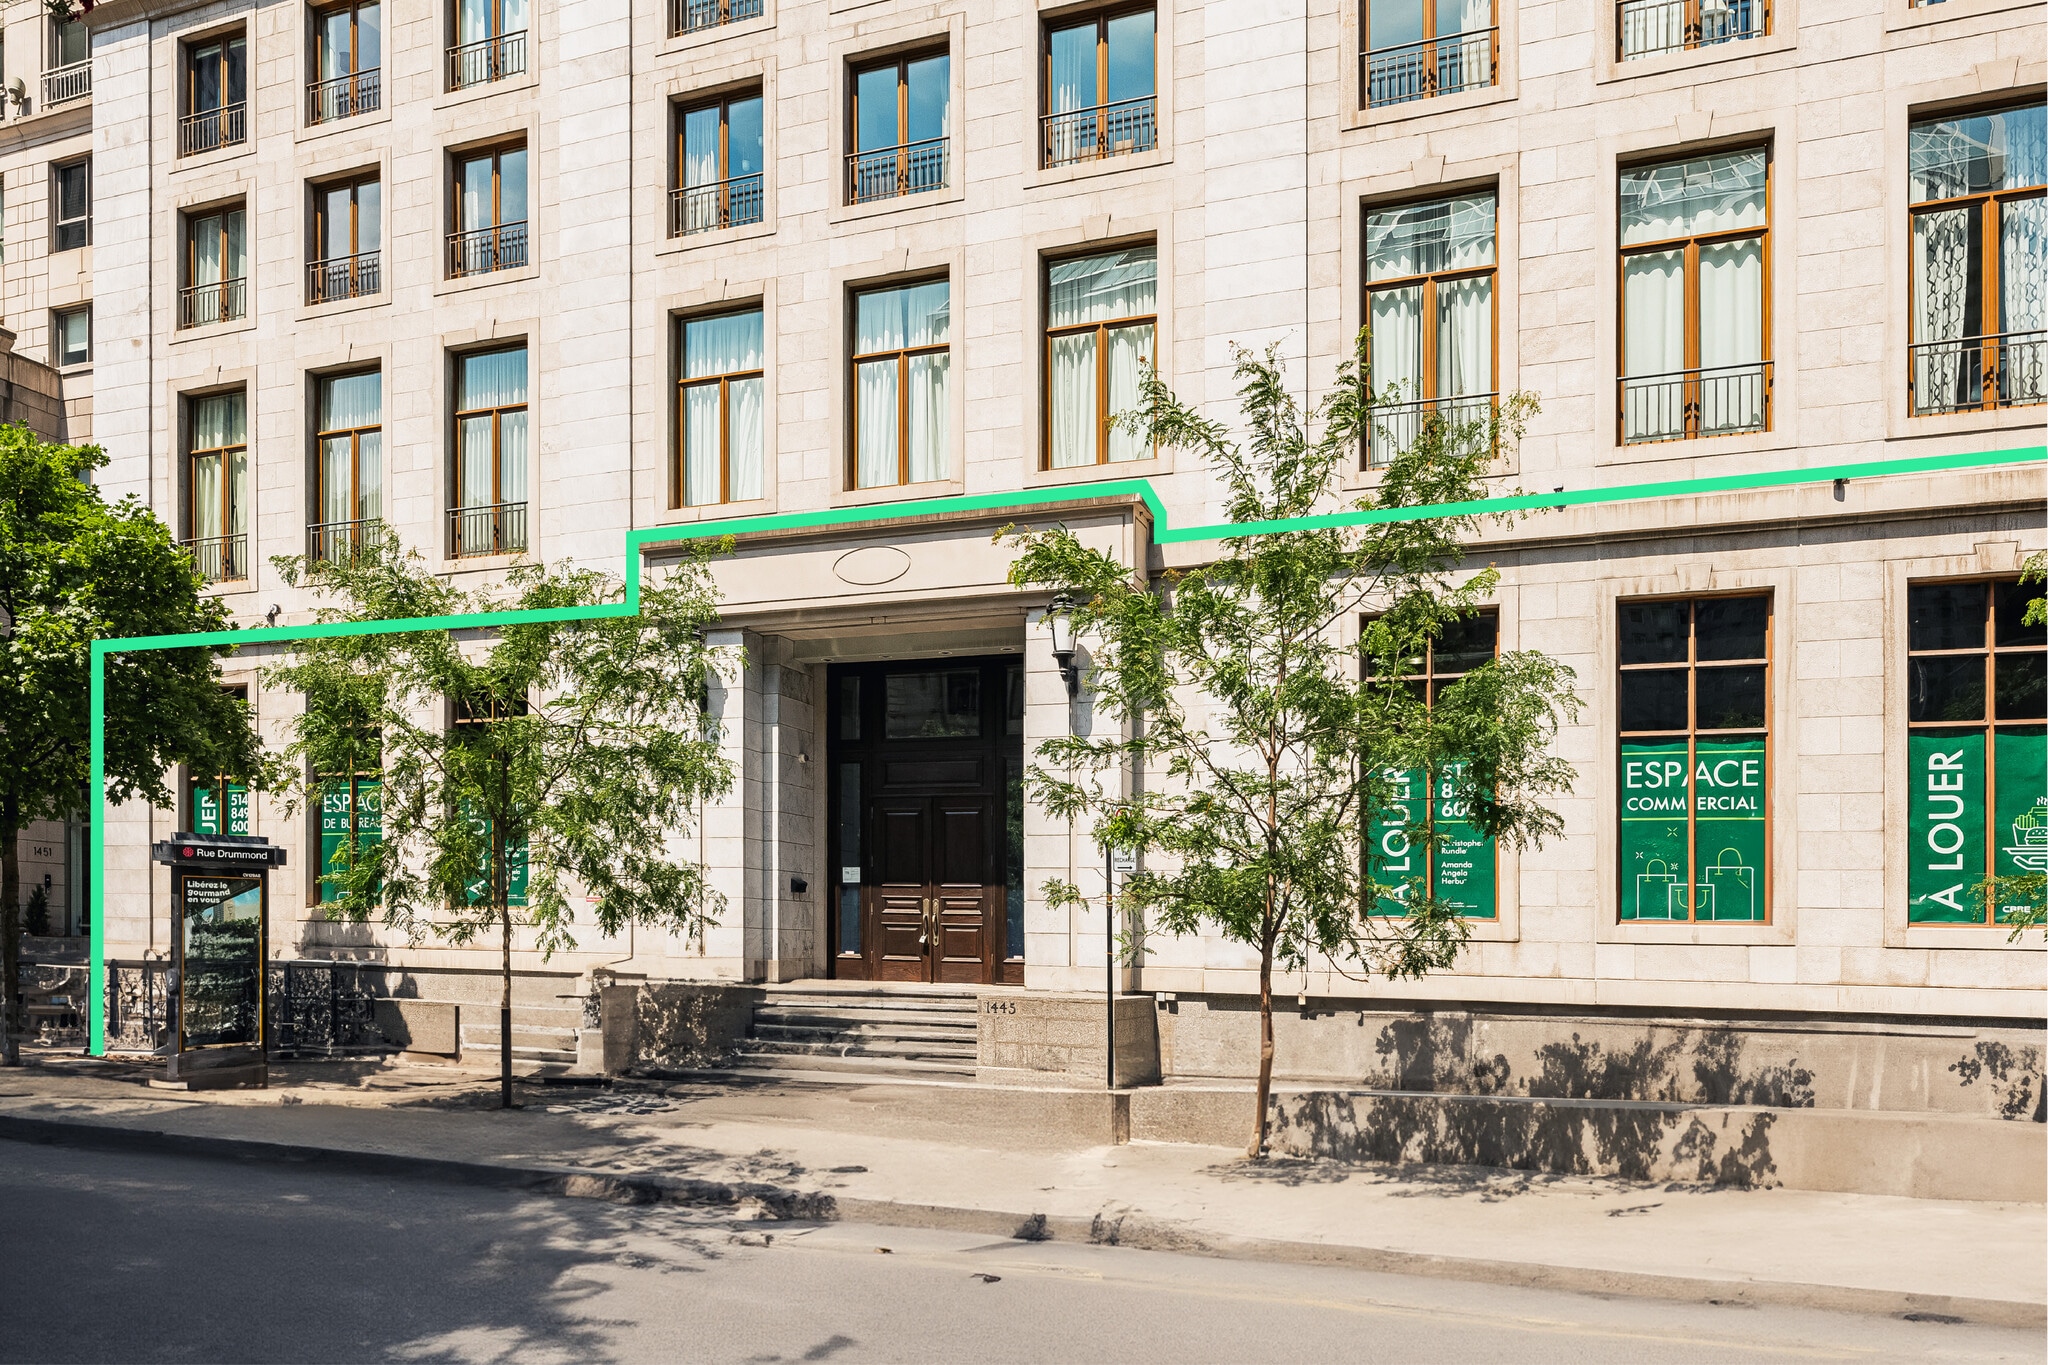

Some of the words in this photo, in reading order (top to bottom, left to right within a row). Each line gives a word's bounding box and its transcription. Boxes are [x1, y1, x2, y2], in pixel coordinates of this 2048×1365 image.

[1627, 760, 1758, 788] ESPACE
[324, 792, 383, 812] ESPAC
[1627, 796, 1758, 811] COMMERCIAL
[1927, 749, 1964, 870] LOUER
[324, 818, 336, 829] DE
[33, 846, 52, 857] 1451
[197, 848, 215, 857] Rue
[218, 850, 268, 860] Drummond
[1441, 869, 1468, 878] Angela
[187, 880, 219, 889] Libérez
[220, 881, 228, 889] le
[187, 888, 231, 897] gourmand
[1919, 883, 1963, 912] À
[985, 1001, 1016, 1015] 1445
